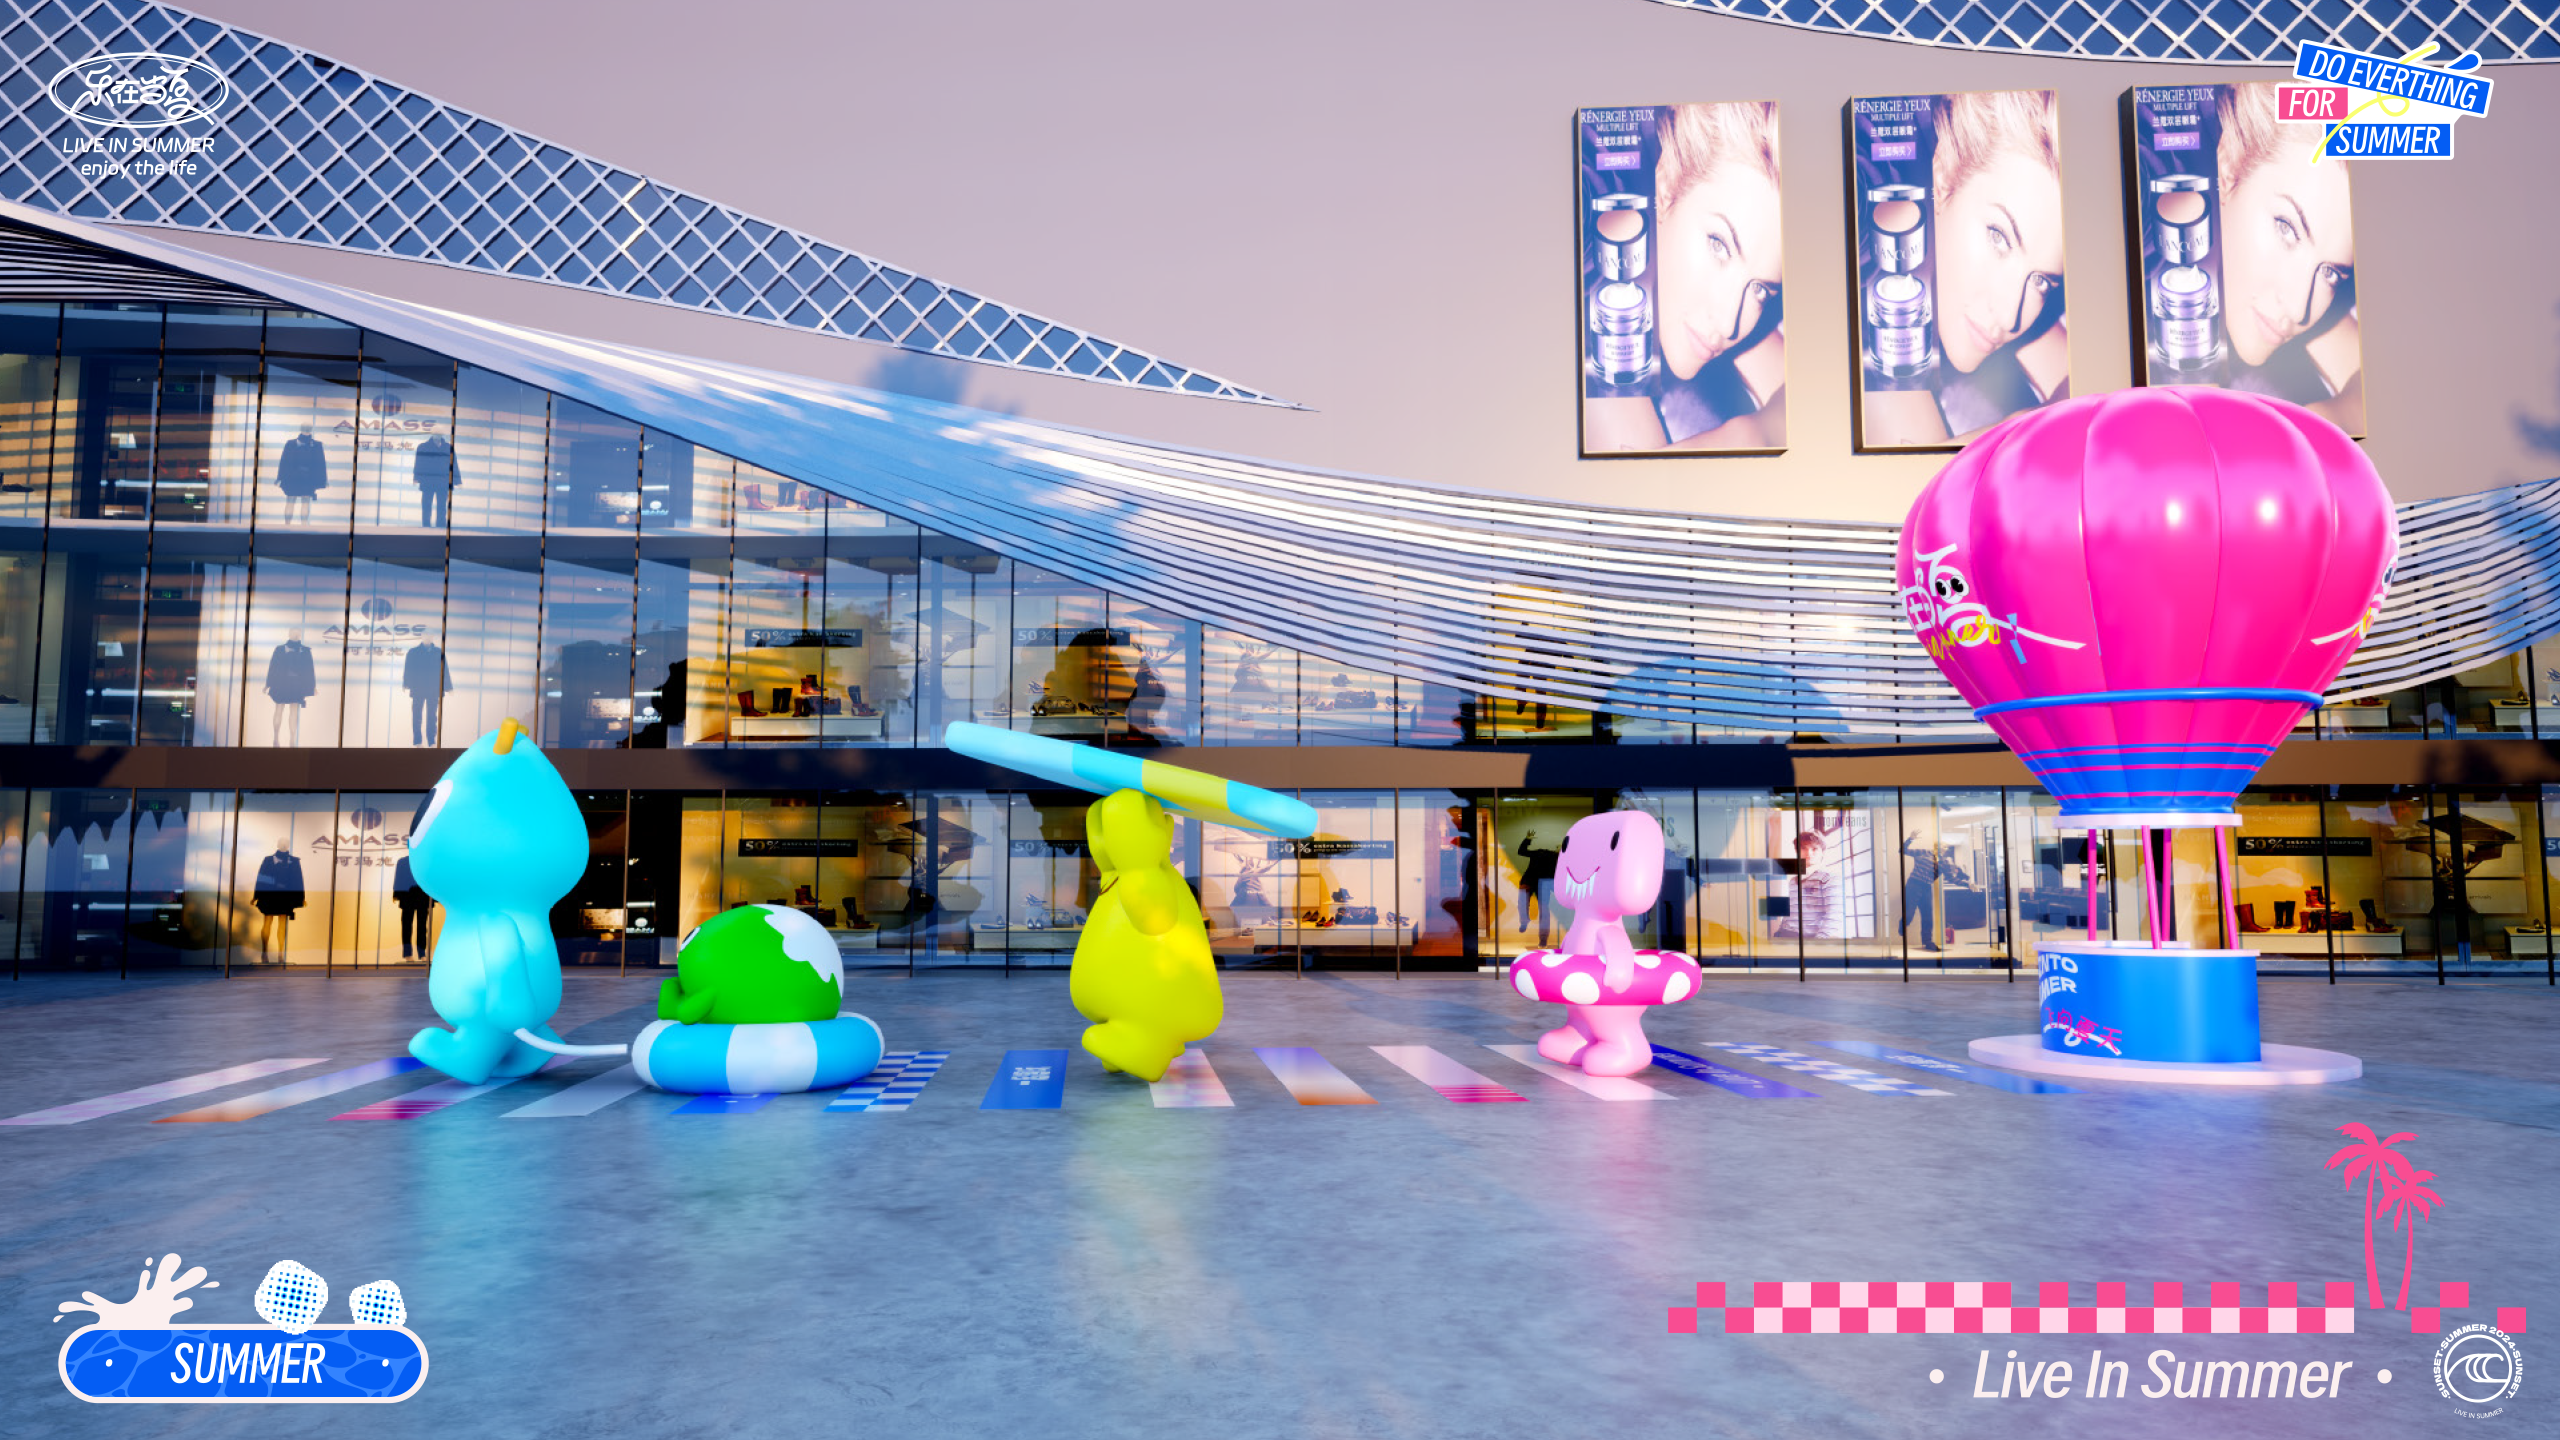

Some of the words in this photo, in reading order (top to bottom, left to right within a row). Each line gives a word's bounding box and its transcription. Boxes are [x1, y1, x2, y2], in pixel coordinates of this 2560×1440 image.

[2187, 87, 2214, 101] YEUX
[1904, 98, 1931, 112] YEUX
[1629, 109, 1655, 121] YEUX
[745, 840, 781, 852] 50%
[2245, 838, 2285, 850] 50%
